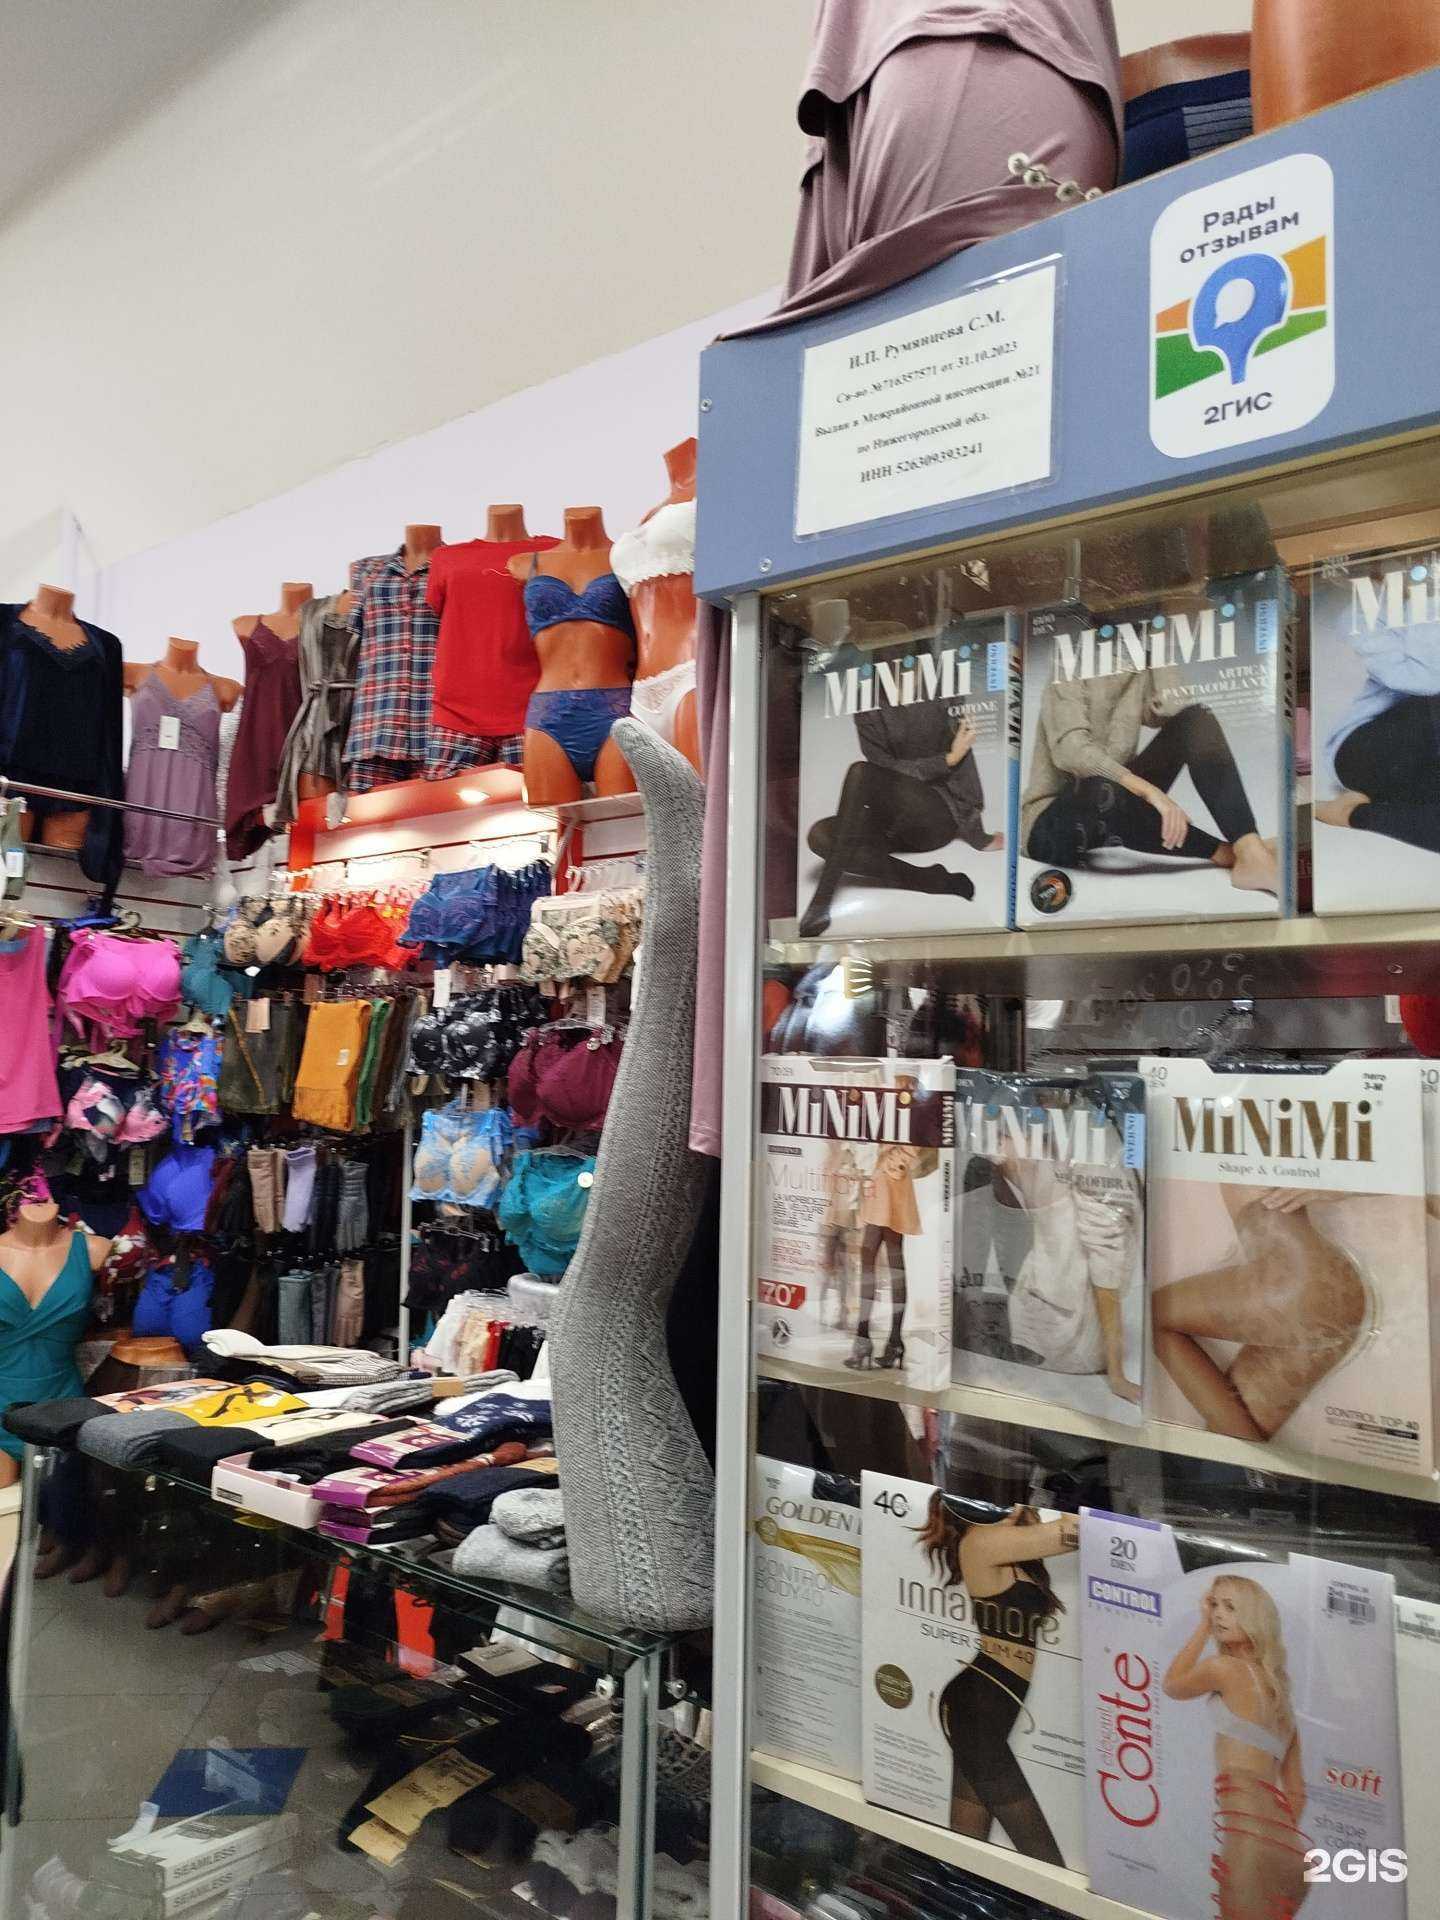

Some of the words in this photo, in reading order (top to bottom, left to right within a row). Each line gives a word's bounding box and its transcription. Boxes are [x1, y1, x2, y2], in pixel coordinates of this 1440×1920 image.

[1203, 197, 1276, 233] Рады
[1180, 212, 1300, 264] отзывам
[849, 350, 881, 370] И.П.
[884, 324, 964, 360] Румянцева
[968, 310, 1006, 332] С.М.
[862, 394, 942, 424] Межрайонной
[1203, 392, 1273, 426] 2ГИС
[872, 418, 962, 450] Нижегородской
[860, 465, 892, 483] ИНН
[1052, 602, 1238, 685] MiNiMi
[824, 644, 973, 719] MiNiMi
[777, 1085, 912, 1144] MiNiMi
[1172, 1096, 1377, 1163] MiNiMi
[1218, 1161, 1254, 1176] Shape
[1273, 1164, 1321, 1178] Control
[766, 1495, 853, 1531] GOLDEN
[1110, 1536, 1137, 1560] 20
[920, 1622, 972, 1648] SUPER
[1097, 1652, 1161, 1828] Conte
[1326, 1767, 1385, 1797] soft
